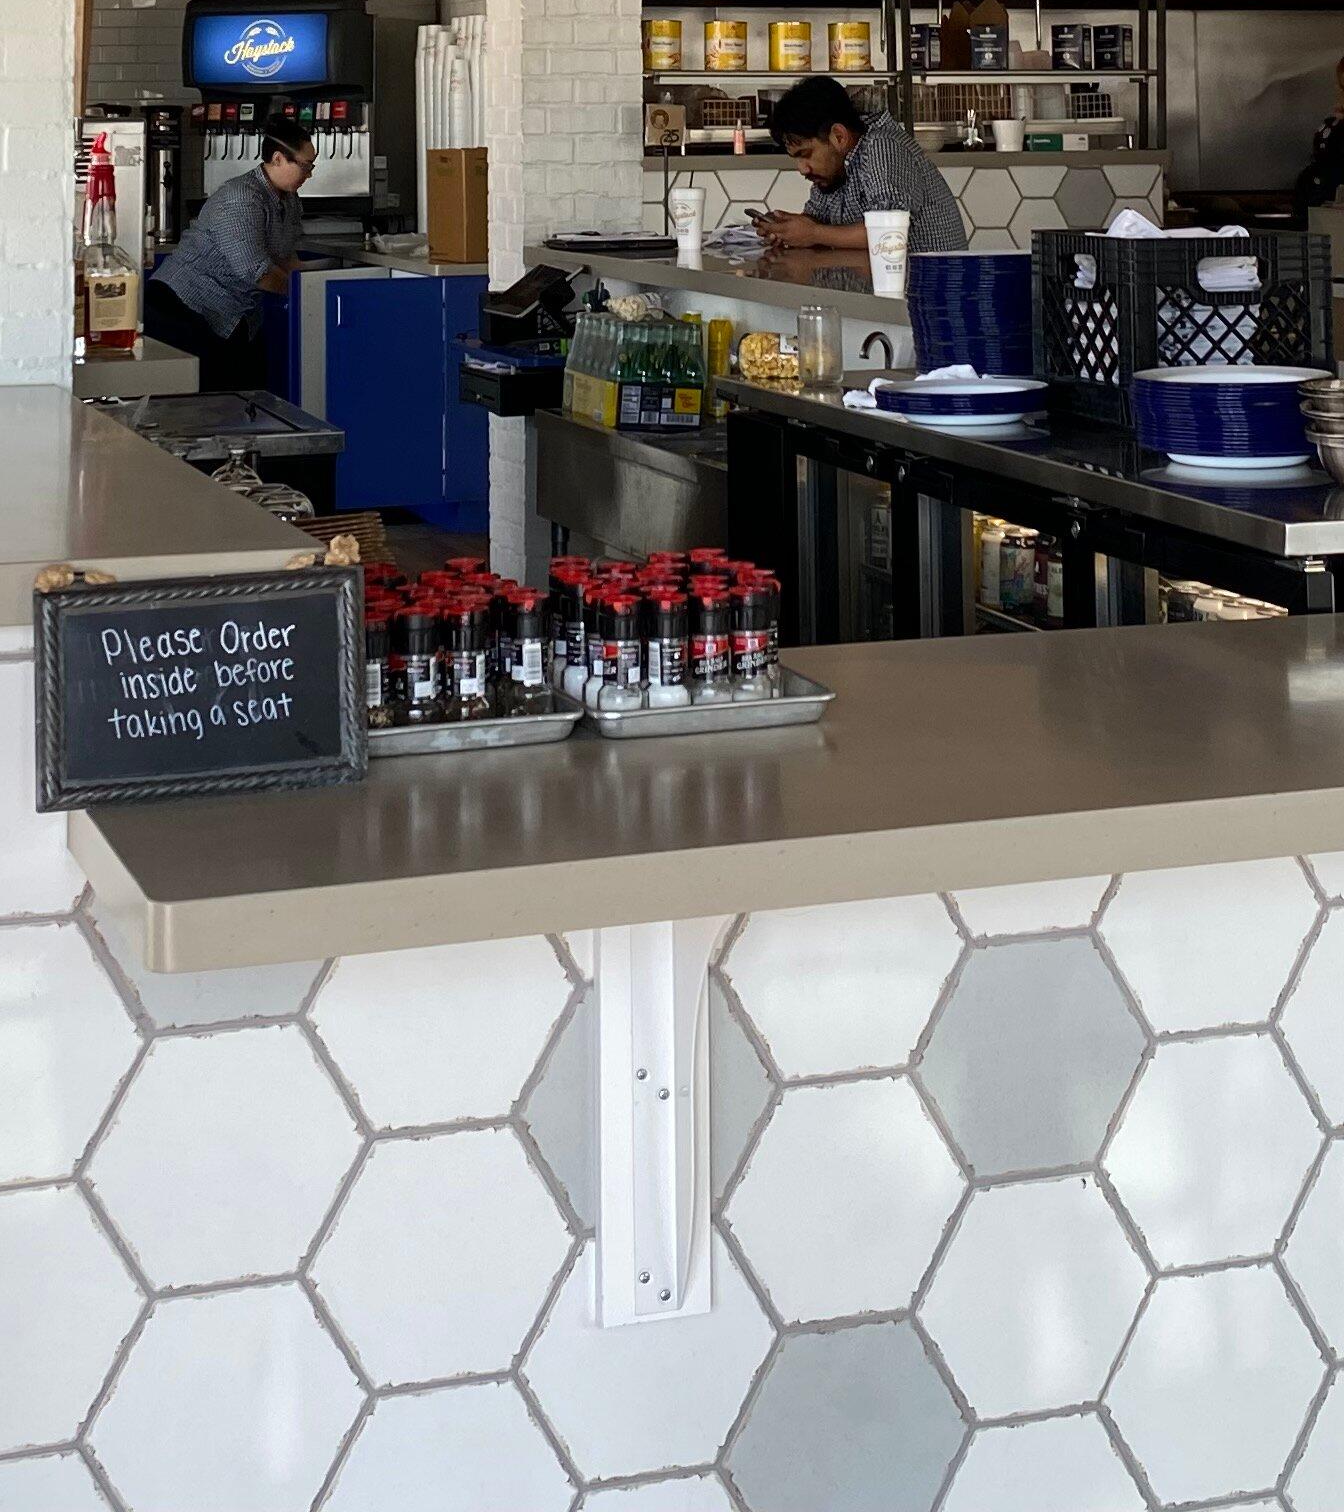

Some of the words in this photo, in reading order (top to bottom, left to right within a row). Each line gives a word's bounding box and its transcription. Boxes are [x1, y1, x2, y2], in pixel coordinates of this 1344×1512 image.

[224, 35, 296, 65] Haystack
[101, 626, 203, 666] Please
[220, 621, 296, 654] Order
[119, 665, 197, 700] inside
[213, 656, 295, 688] before
[108, 708, 203, 740] taking
[210, 704, 227, 726] a
[232, 692, 293, 727] seat
